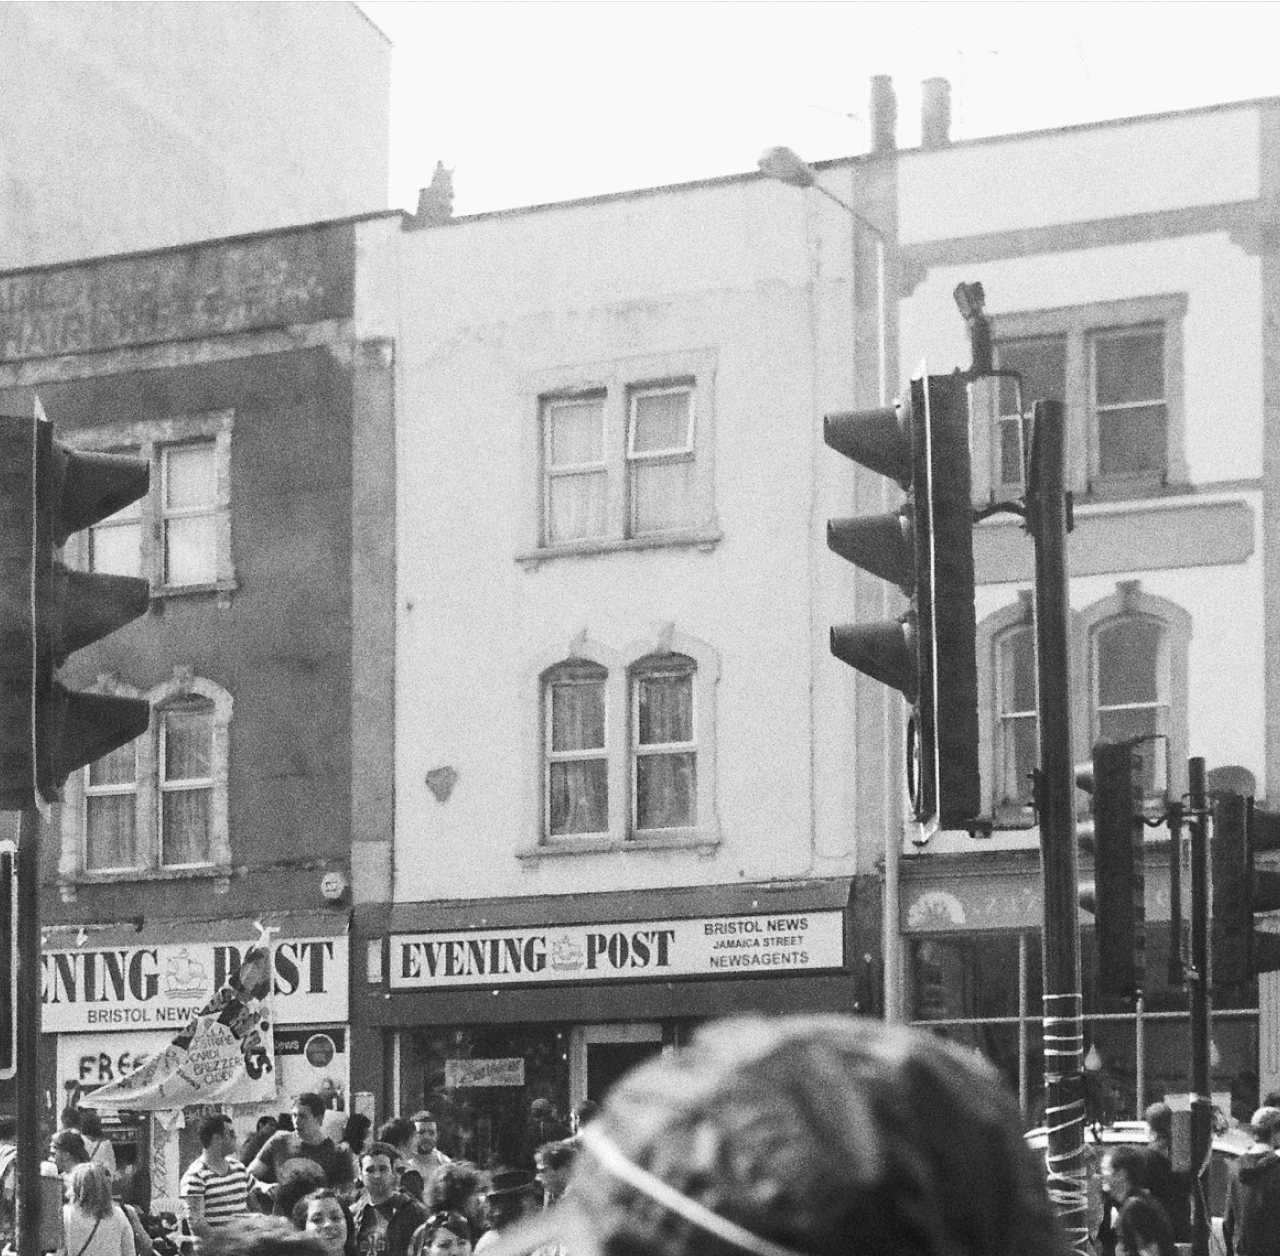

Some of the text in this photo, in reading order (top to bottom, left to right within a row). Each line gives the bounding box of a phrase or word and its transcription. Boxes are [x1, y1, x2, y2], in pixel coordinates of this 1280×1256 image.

[704, 918, 808, 936] BRISTOL NEWS
[713, 935, 804, 950] JAMAICA STREET
[401, 930, 675, 979] EVENING POST
[709, 951, 809, 968] NEWSAGENTS
[213, 941, 333, 997] PST
[88, 1009, 151, 1024] BRISTOL
